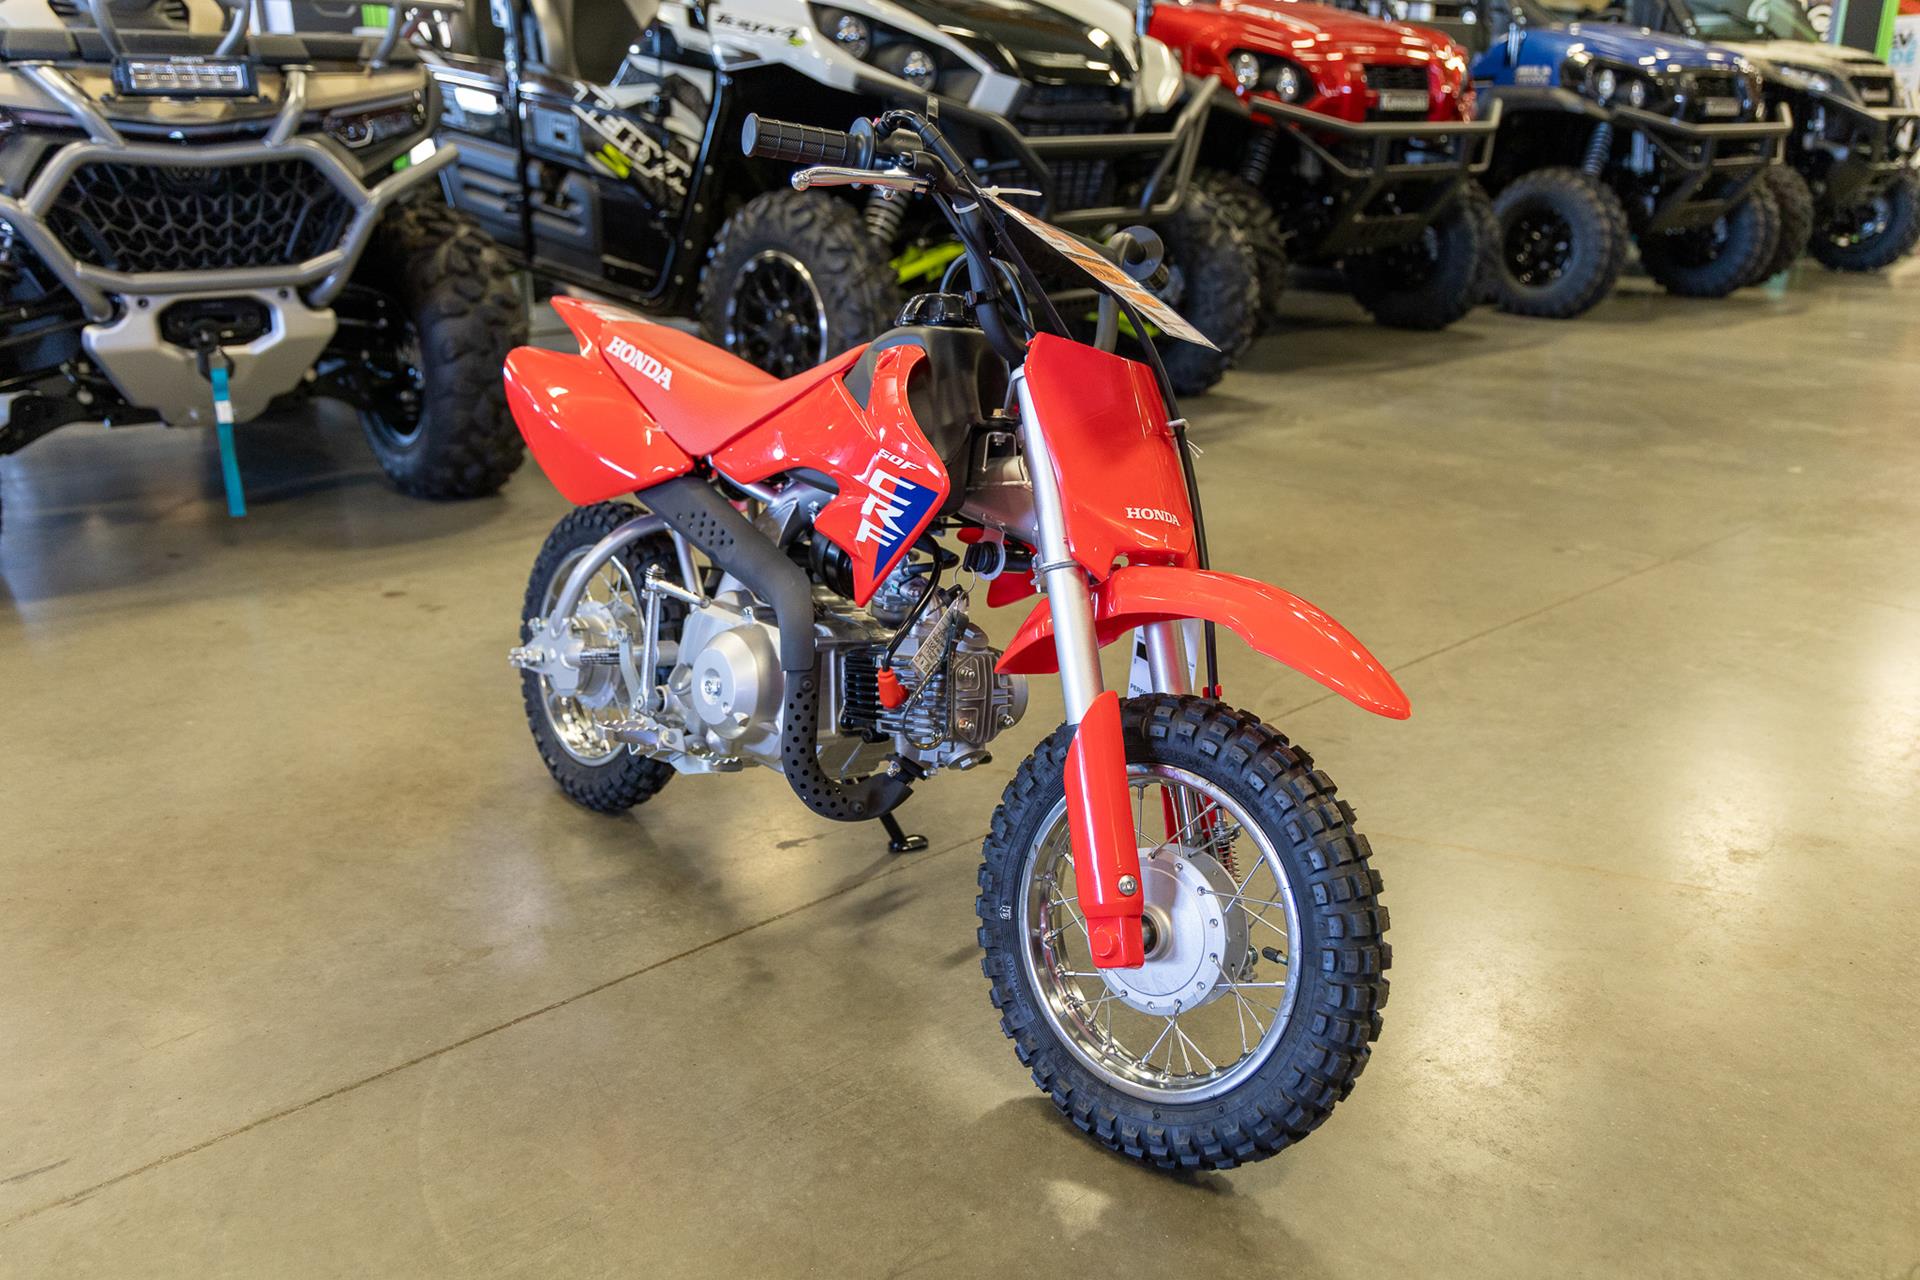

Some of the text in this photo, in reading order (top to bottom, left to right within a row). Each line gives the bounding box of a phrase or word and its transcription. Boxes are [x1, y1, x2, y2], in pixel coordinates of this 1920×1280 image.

[605, 335, 672, 391] HONDA
[877, 447, 924, 470] 50F
[855, 468, 916, 547] CRF
[1125, 507, 1181, 527] HONDA
